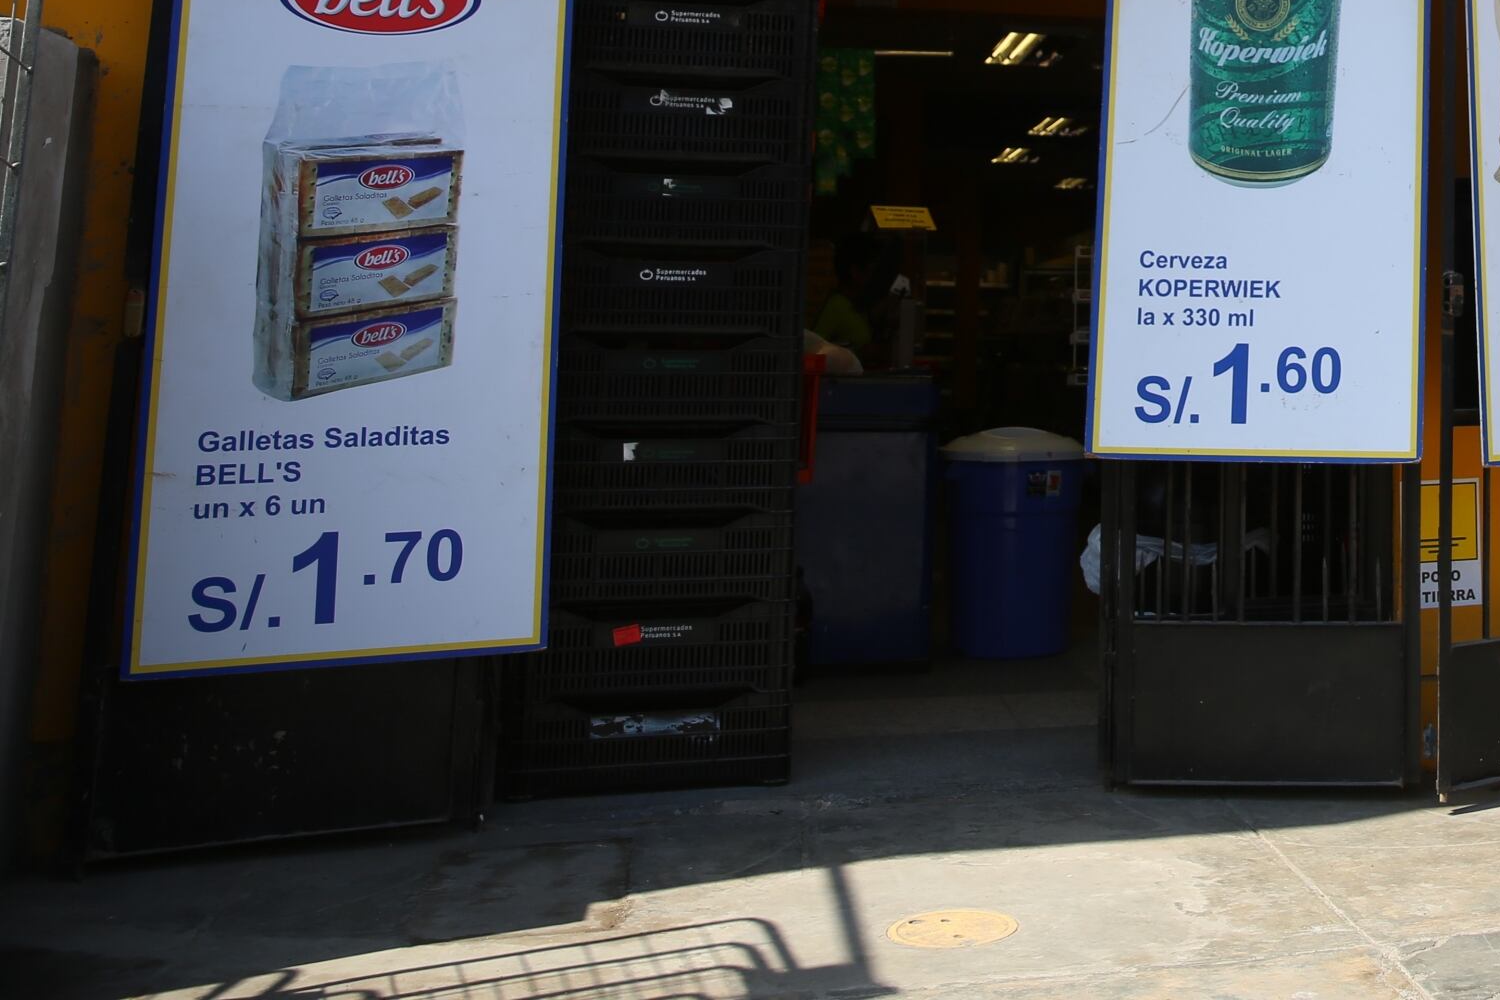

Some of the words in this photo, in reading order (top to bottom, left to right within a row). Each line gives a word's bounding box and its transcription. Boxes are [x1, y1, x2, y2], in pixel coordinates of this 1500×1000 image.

[1215, 80, 1302, 103] Premium
[1219, 106, 1295, 134] Quality
[1221, 145, 1263, 157] ORIGINAL
[1265, 147, 1292, 157] LAGER
[368, 169, 405, 185] bell's
[364, 249, 400, 266] bell's
[1139, 250, 1228, 270] Cerveza
[1138, 279, 1281, 299] KOPERWIEK
[1162, 312, 1175, 326] x
[1182, 308, 1220, 327] 330
[1228, 309, 1254, 327] ml
[361, 326, 397, 344] bell's
[198, 430, 314, 453] Galletas
[324, 426, 450, 449] Saladitas
[195, 461, 302, 486] BELL'S
[193, 500, 229, 520] un
[239, 499, 255, 518] x
[265, 495, 282, 517] 6
[291, 494, 326, 515] un
[1422, 570, 1461, 583] POO
[1422, 589, 1476, 603] TIRA
